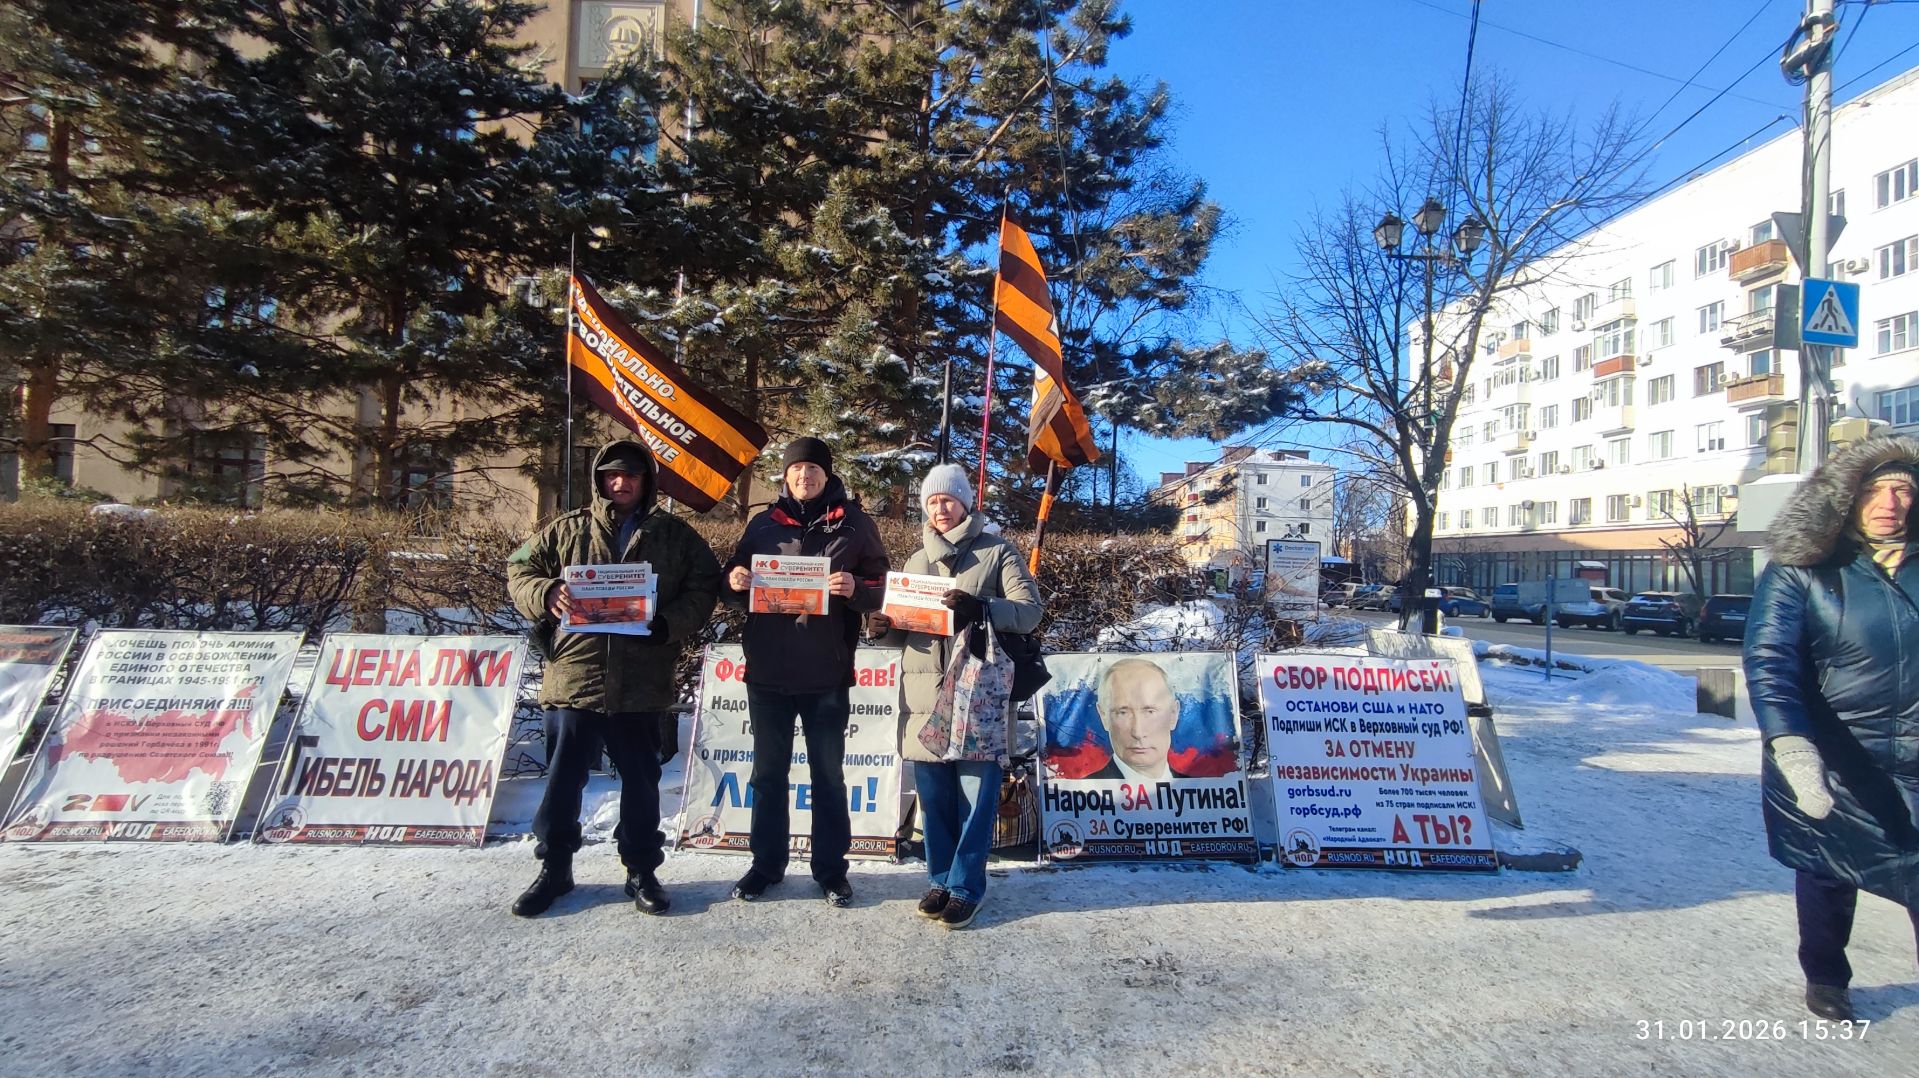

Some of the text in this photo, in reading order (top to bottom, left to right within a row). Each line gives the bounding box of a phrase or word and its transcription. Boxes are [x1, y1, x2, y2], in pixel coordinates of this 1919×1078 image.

[574, 287, 677, 401] АОНАЛЬНО-
[226, 640, 275, 649] АРМИИ
[96, 652, 277, 661] РОССИИ В ОСВОБОЖДЕНИИ
[109, 664, 251, 672] ЕДИНОГО ОТЕЧЕСТВА
[325, 648, 513, 692] ЦЕНА ЛЖИ
[854, 663, 896, 686] ав!
[89, 676, 99, 684] В
[100, 676, 174, 686] ГРАНИЦАХ
[1274, 662, 1454, 695] СБОР ПОДПИСЕЙ!
[87, 697, 251, 711] ПРИСОЕДИНЯЙСЯ!!!
[712, 696, 748, 712] Надо
[1286, 700, 1444, 715] ОСТАНОВИ США и НАТО
[356, 698, 453, 742] СМИ
[1272, 716, 1464, 738] Подпиши ИСК в Верховный суд РФ!
[702, 748, 710, 760] о
[714, 748, 752, 764] призн
[1325, 740, 1415, 758] ЗА ОТМЕНУ
[280, 736, 494, 806] ГИБЕЛЬ НАРОДА
[1277, 764, 1473, 786] независимости Украины
[1044, 780, 1246, 818] Народ ЗА Путина!
[1288, 785, 1352, 799] gorbsud.ru
[1378, 787, 1468, 797] Более 700 тысяч человек
[1290, 804, 1362, 818] горбсуд.рф
[1396, 802, 1415, 810] стран
[1416, 802, 1455, 810] подписали
[50, 827, 103, 836] RUSNOD.RU
[270, 830, 292, 839] НОД
[306, 830, 357, 838] RUSNOD.RU
[363, 825, 408, 842] НОД
[414, 830, 476, 840] EAFEDOROV.RU
[1089, 817, 1249, 839] ЗА Суверенитет РФ!
[1392, 814, 1472, 846] А ТЫ?
[850, 840, 888, 850] DOROV.RU
[1056, 846, 1076, 854] НОД
[1089, 845, 1136, 854] RUSNOD.RU
[1145, 840, 1184, 856] НОД
[1190, 843, 1250, 852] EAFEDOROV.RU
[1294, 854, 1314, 862] НОД
[1328, 852, 1374, 862] RUSNOD.RU
[1384, 850, 1423, 867] НОД
[1430, 854, 1490, 864] EAFEDOROV.RU
